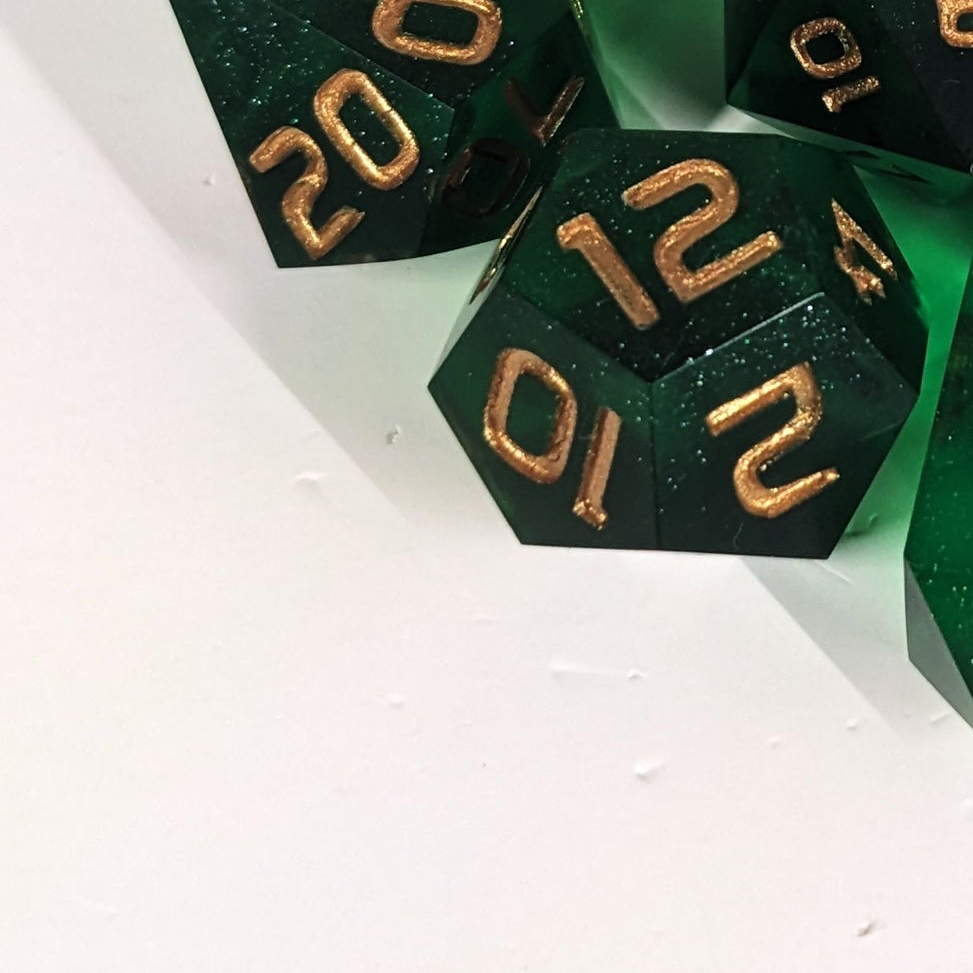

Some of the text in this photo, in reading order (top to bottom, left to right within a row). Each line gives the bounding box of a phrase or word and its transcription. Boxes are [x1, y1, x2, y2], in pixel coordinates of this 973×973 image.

[790, 17, 880, 113] 10
[249, 68, 420, 260] 20
[555, 158, 784, 330] 12
[483, 348, 622, 530] 10
[705, 361, 841, 519] 2
